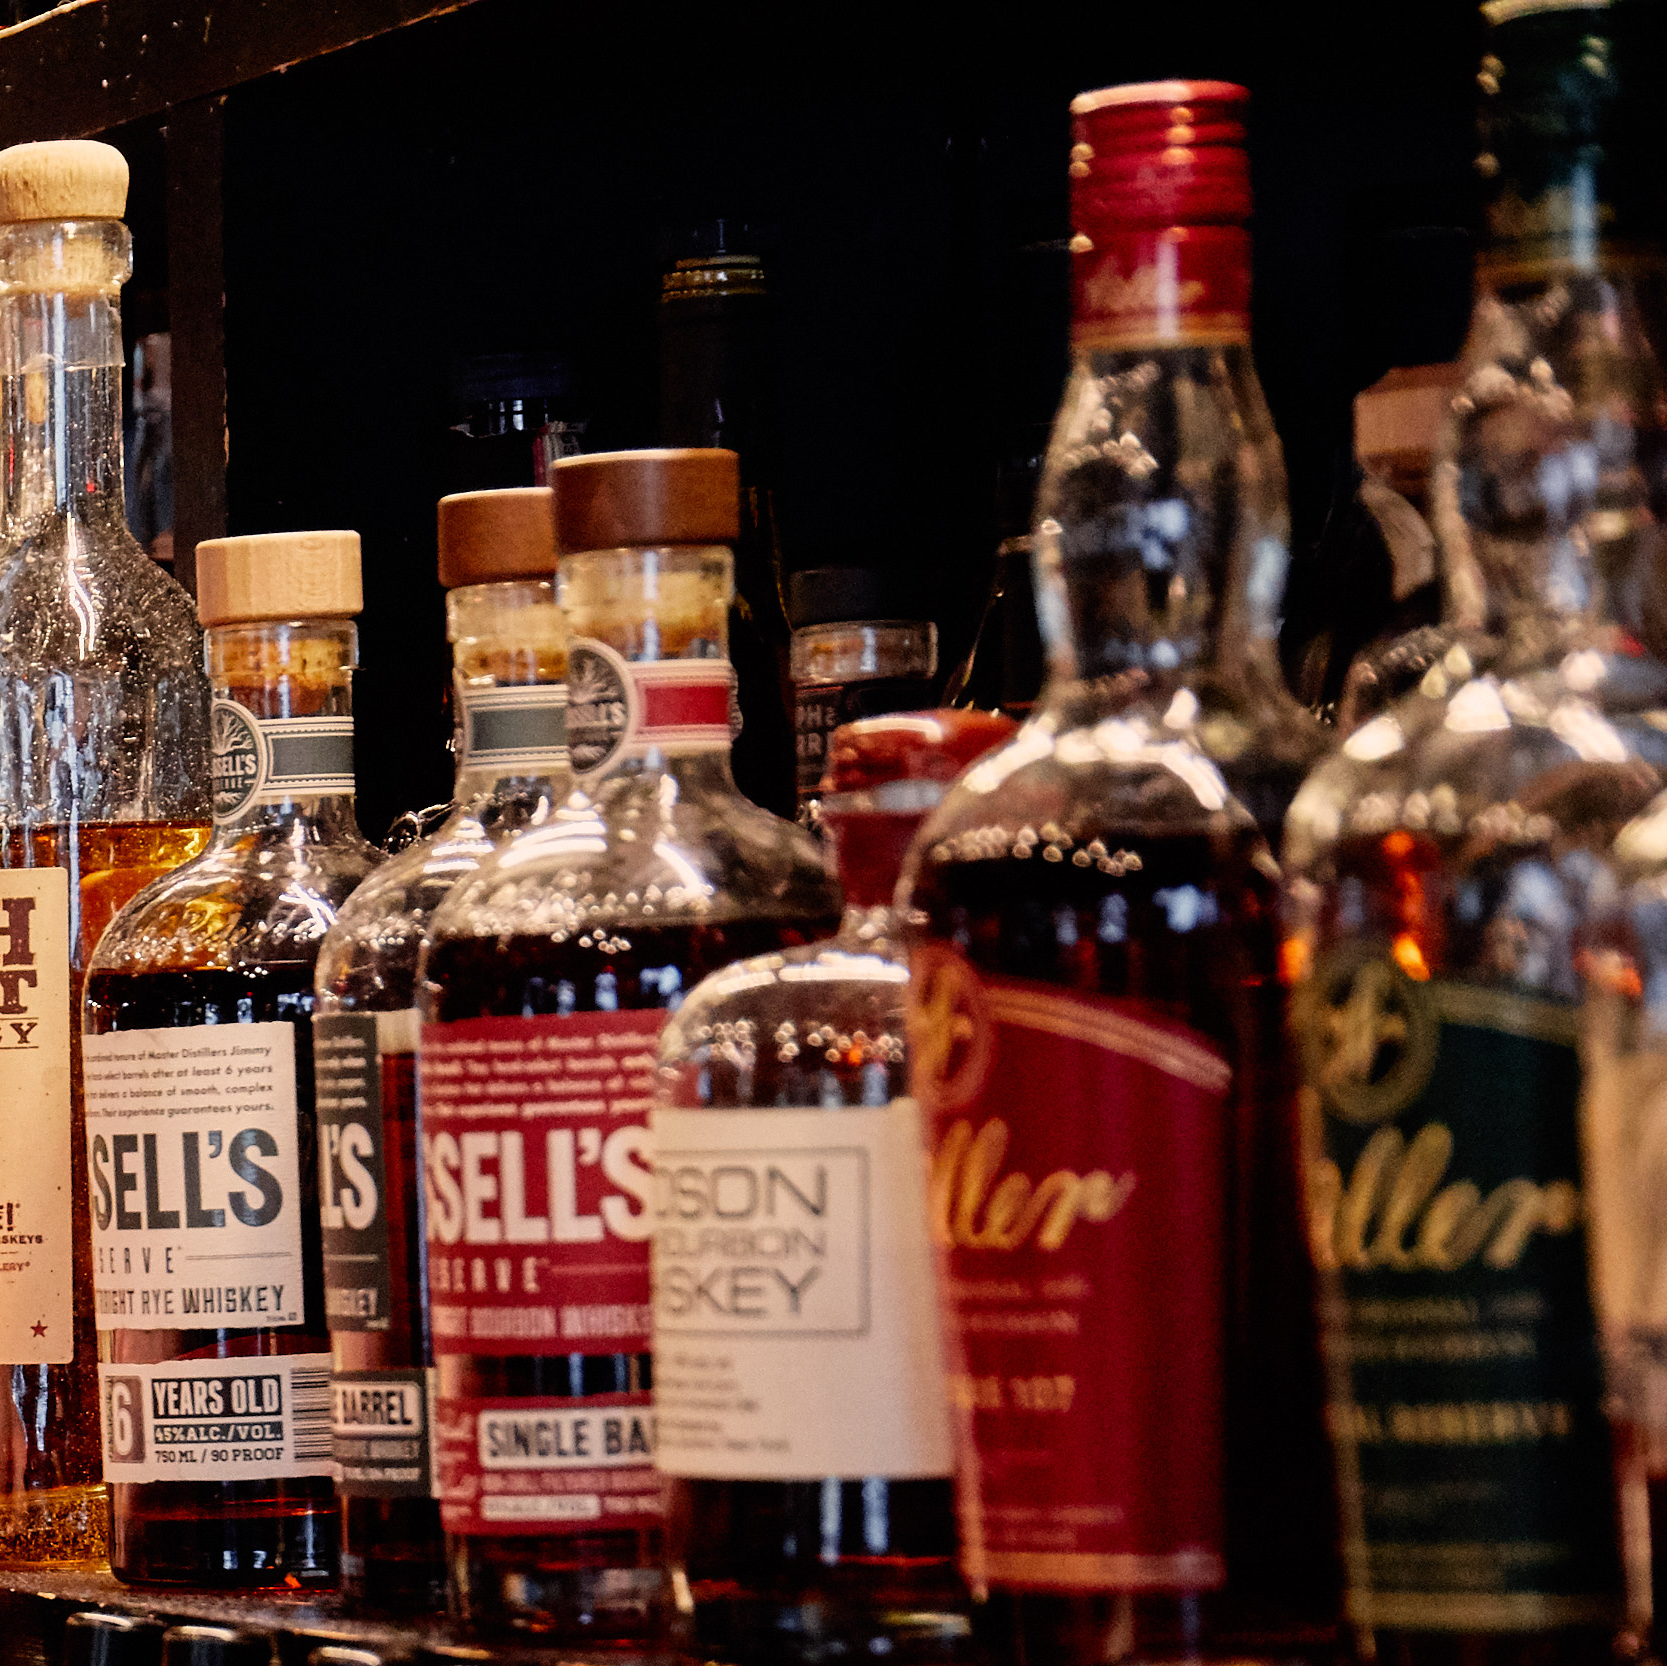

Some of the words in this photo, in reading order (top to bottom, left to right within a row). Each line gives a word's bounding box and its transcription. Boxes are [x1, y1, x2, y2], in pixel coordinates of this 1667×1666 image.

[148, 1050, 178, 1060] Master
[182, 1047, 227, 1058] Distillers
[230, 1045, 272, 1057] Jimmy
[151, 1068, 174, 1078] after
[177, 1067, 188, 1077] at
[192, 1066, 221, 1077] least
[225, 1064, 233, 1075] 6
[237, 1065, 273, 1077] years
[130, 1087, 163, 1098] balance
[167, 1085, 176, 1096] of
[225, 1082, 273, 1095] complex
[119, 1106, 165, 1119] experience
[168, 1105, 232, 1118] guarantees
[92, 1127, 284, 1231] SELL'S
[424, 1125, 655, 1245] SELL'S
[141, 1288, 174, 1315] RYE
[181, 1284, 284, 1314] WHISKEY
[112, 1381, 133, 1456] 6
[153, 1380, 224, 1416] YEARS
[230, 1377, 280, 1414] OLD
[486, 1417, 589, 1459] SINGLE
[603, 1414, 654, 1456] BA
[179, 1450, 197, 1463] ML
[232, 1447, 284, 1462] PROOF
